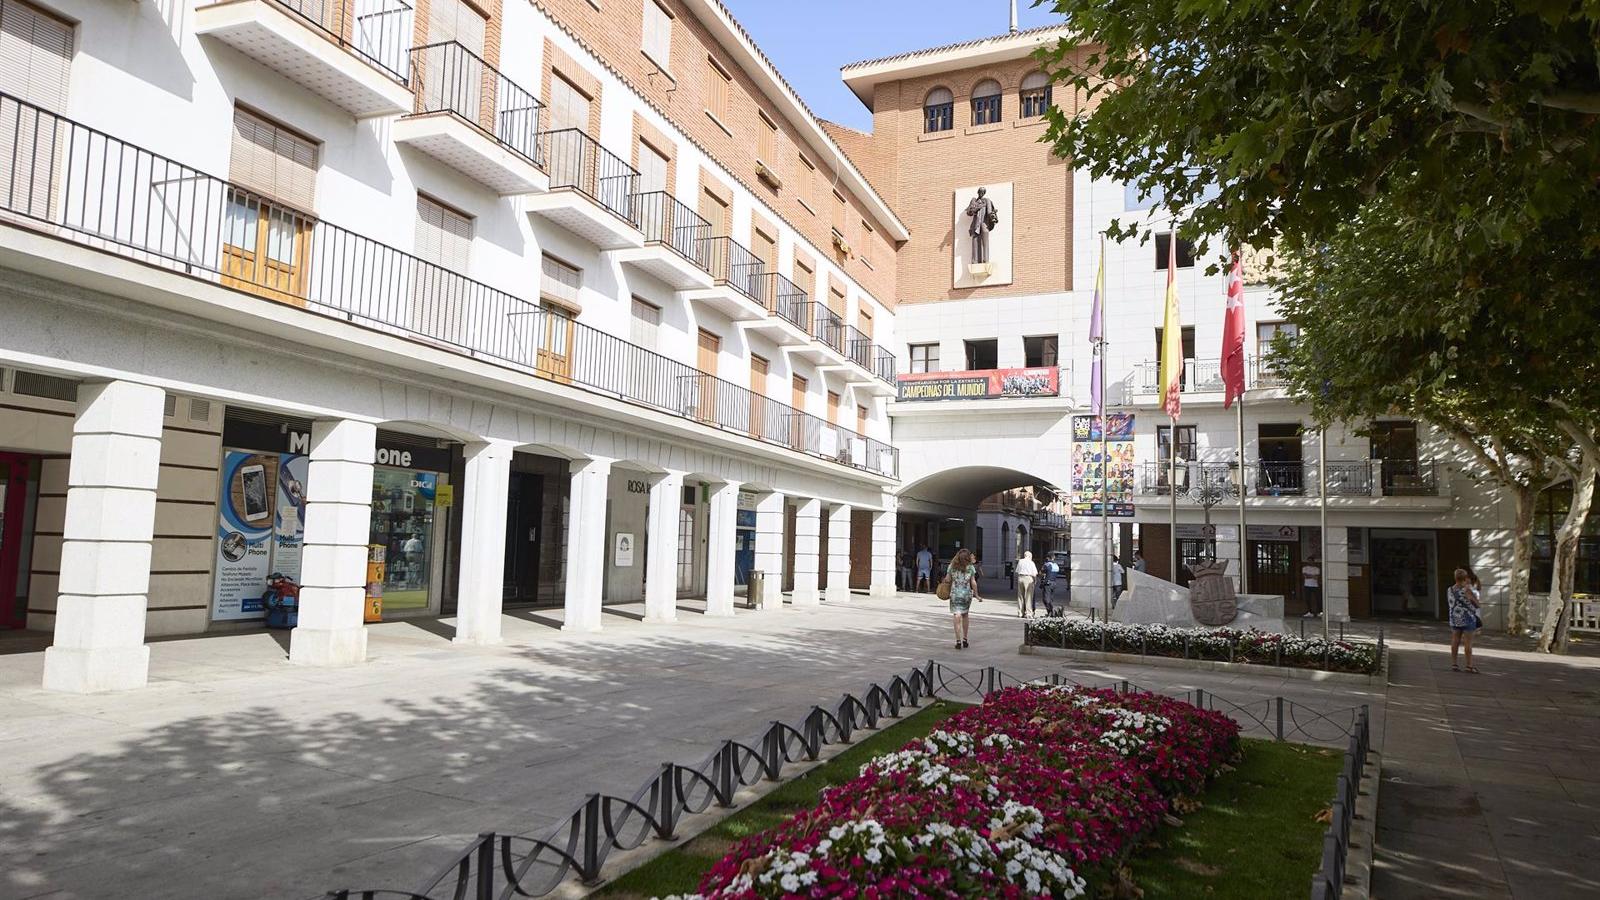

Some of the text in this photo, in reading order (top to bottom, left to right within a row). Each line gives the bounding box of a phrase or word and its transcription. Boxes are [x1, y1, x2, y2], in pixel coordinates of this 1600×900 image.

[902, 382, 986, 398] CAMPEONAS DEL MUNDO!
[290, 431, 412, 467] M one
[628, 480, 645, 494] ROSA
